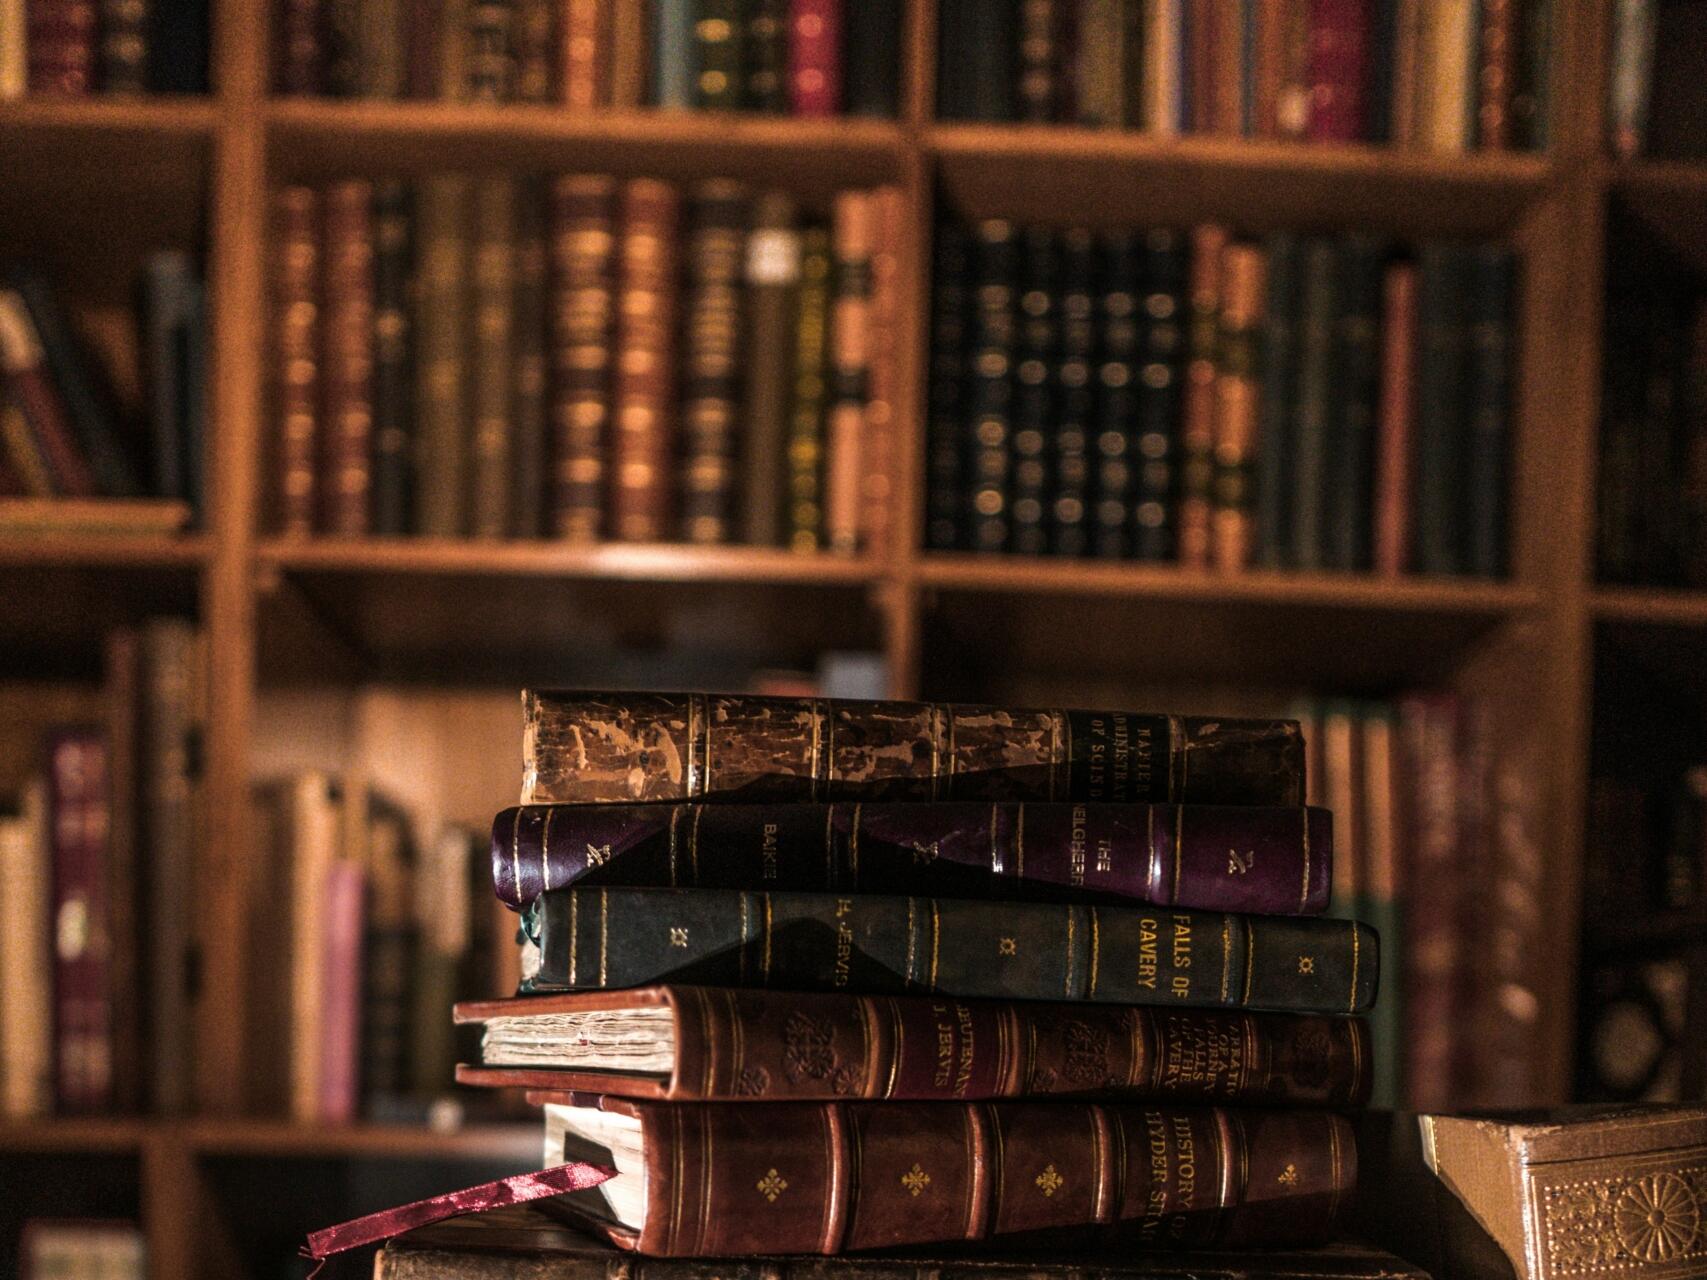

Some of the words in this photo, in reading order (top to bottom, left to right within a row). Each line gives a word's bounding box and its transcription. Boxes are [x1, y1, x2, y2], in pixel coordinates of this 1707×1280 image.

[1096, 838, 1112, 872] THE
[835, 921, 853, 988] JERVIS
[1137, 918, 1158, 990] CAVERY
[1172, 914, 1193, 969] FALLS
[1171, 975, 1191, 999] OF
[934, 1023, 953, 1088] JERVIS
[1163, 1016, 1182, 1089] CAVERY
[1179, 1049, 1195, 1083] THE
[1192, 1027, 1207, 1082] FALLS
[1144, 1111, 1168, 1183] HYDER
[1172, 1116, 1195, 1209] HISTORY
